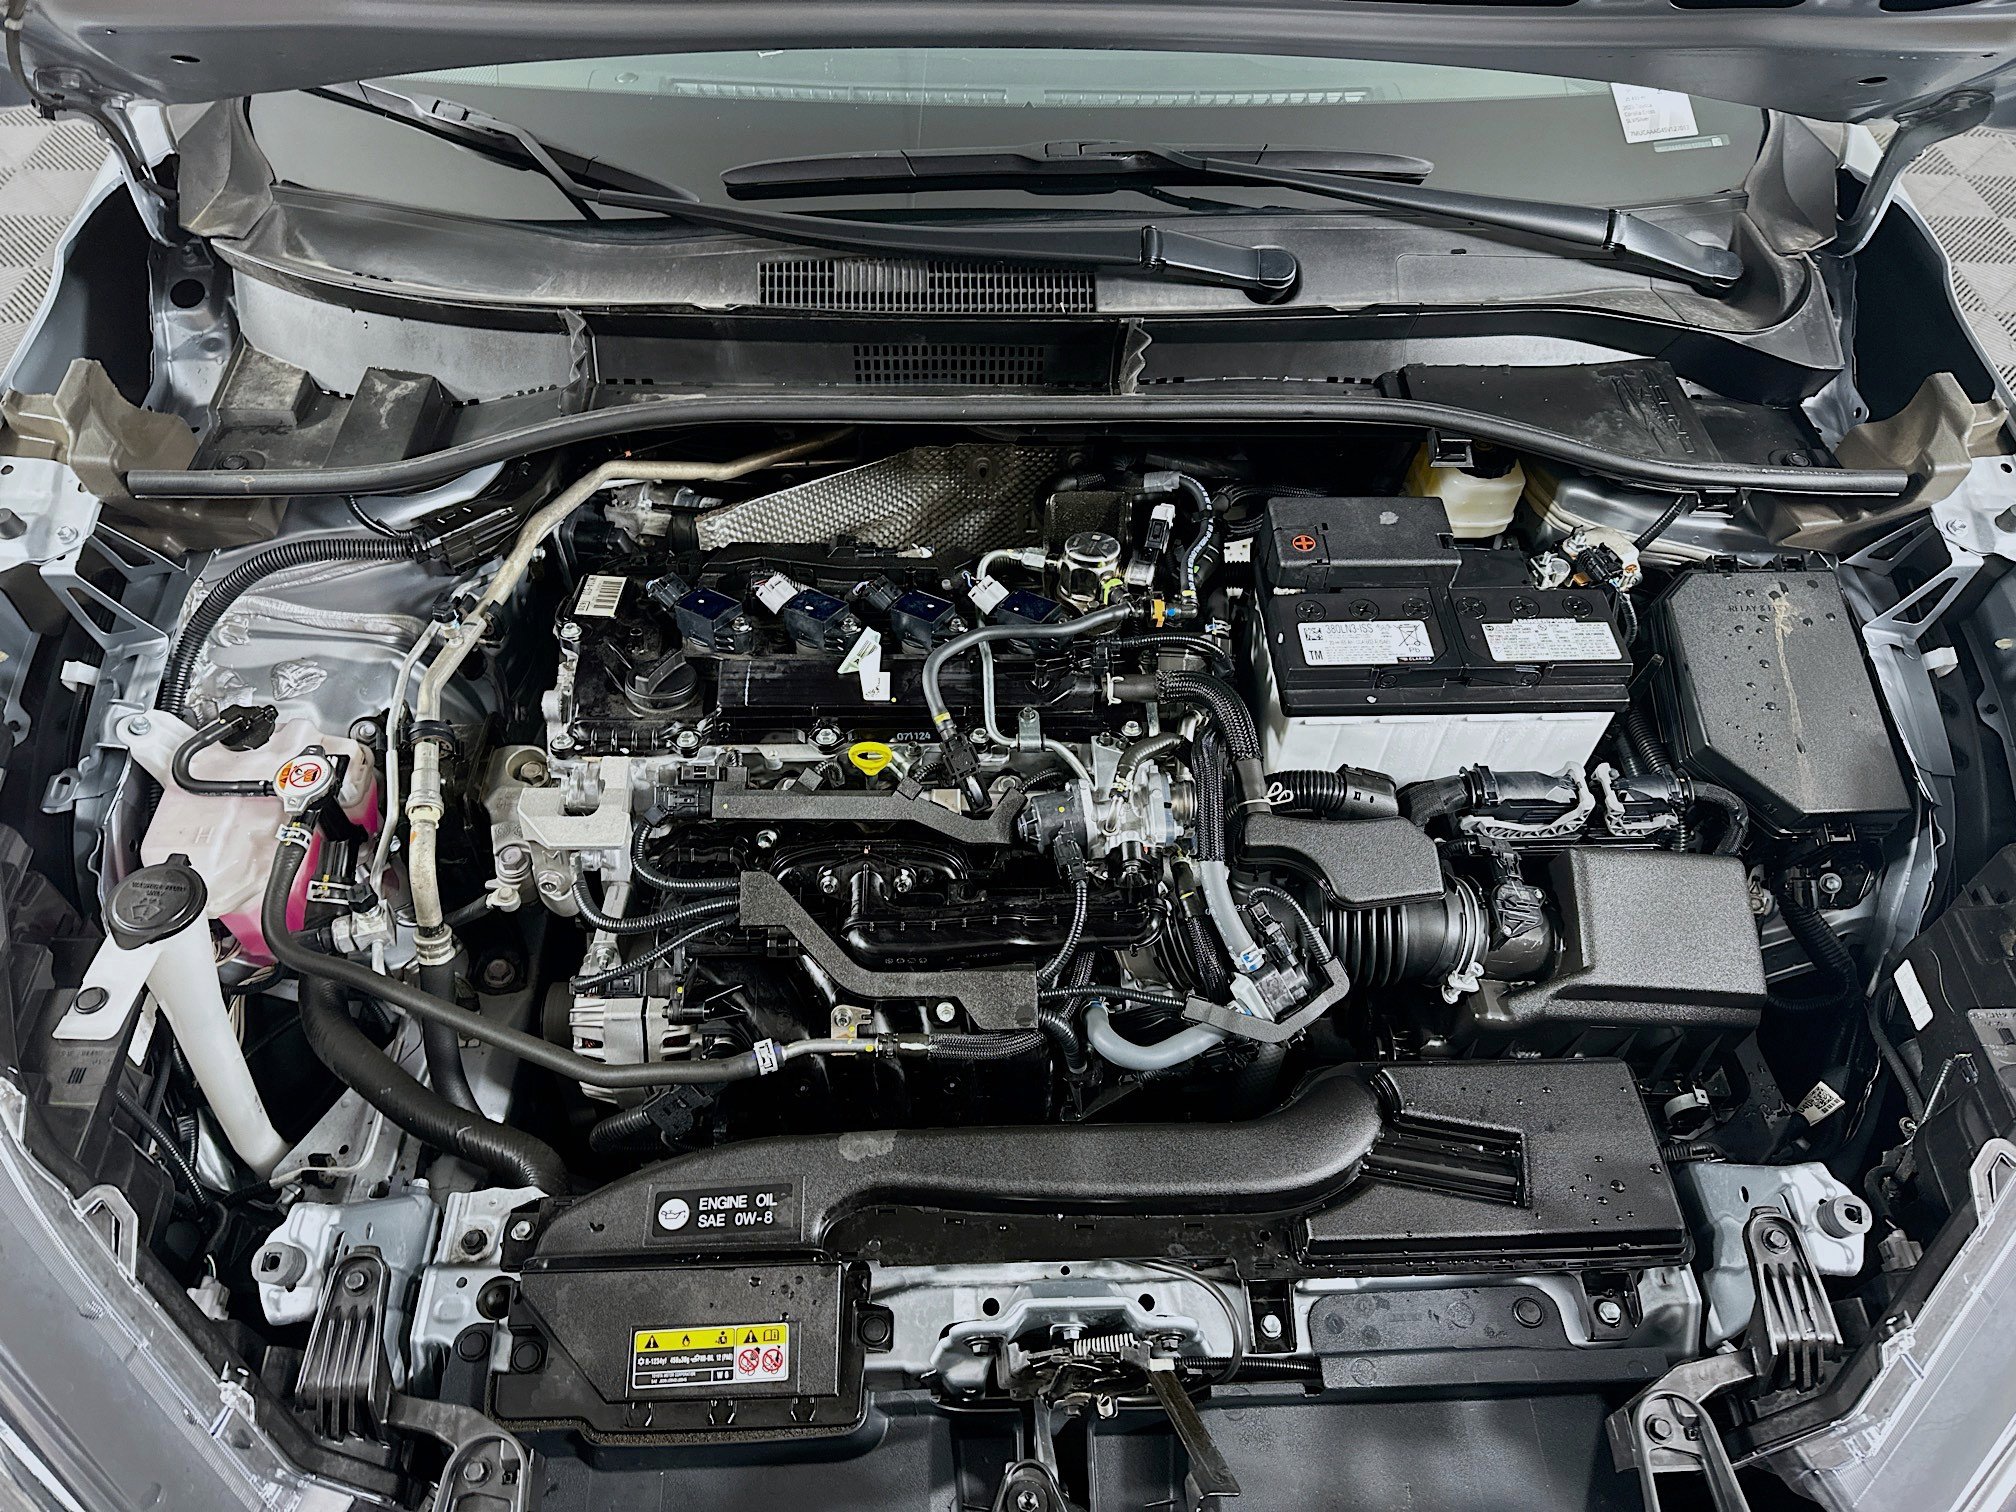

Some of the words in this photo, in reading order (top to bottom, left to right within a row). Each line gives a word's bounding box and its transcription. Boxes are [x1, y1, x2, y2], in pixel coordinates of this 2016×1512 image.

[1309, 650, 1324, 660] TM
[896, 731, 931, 741] 071124
[698, 1194, 748, 1211] ENGINE
[755, 1192, 778, 1207] OIL
[697, 1213, 726, 1228] SAE
[734, 1210, 774, 1226] 0W-8
